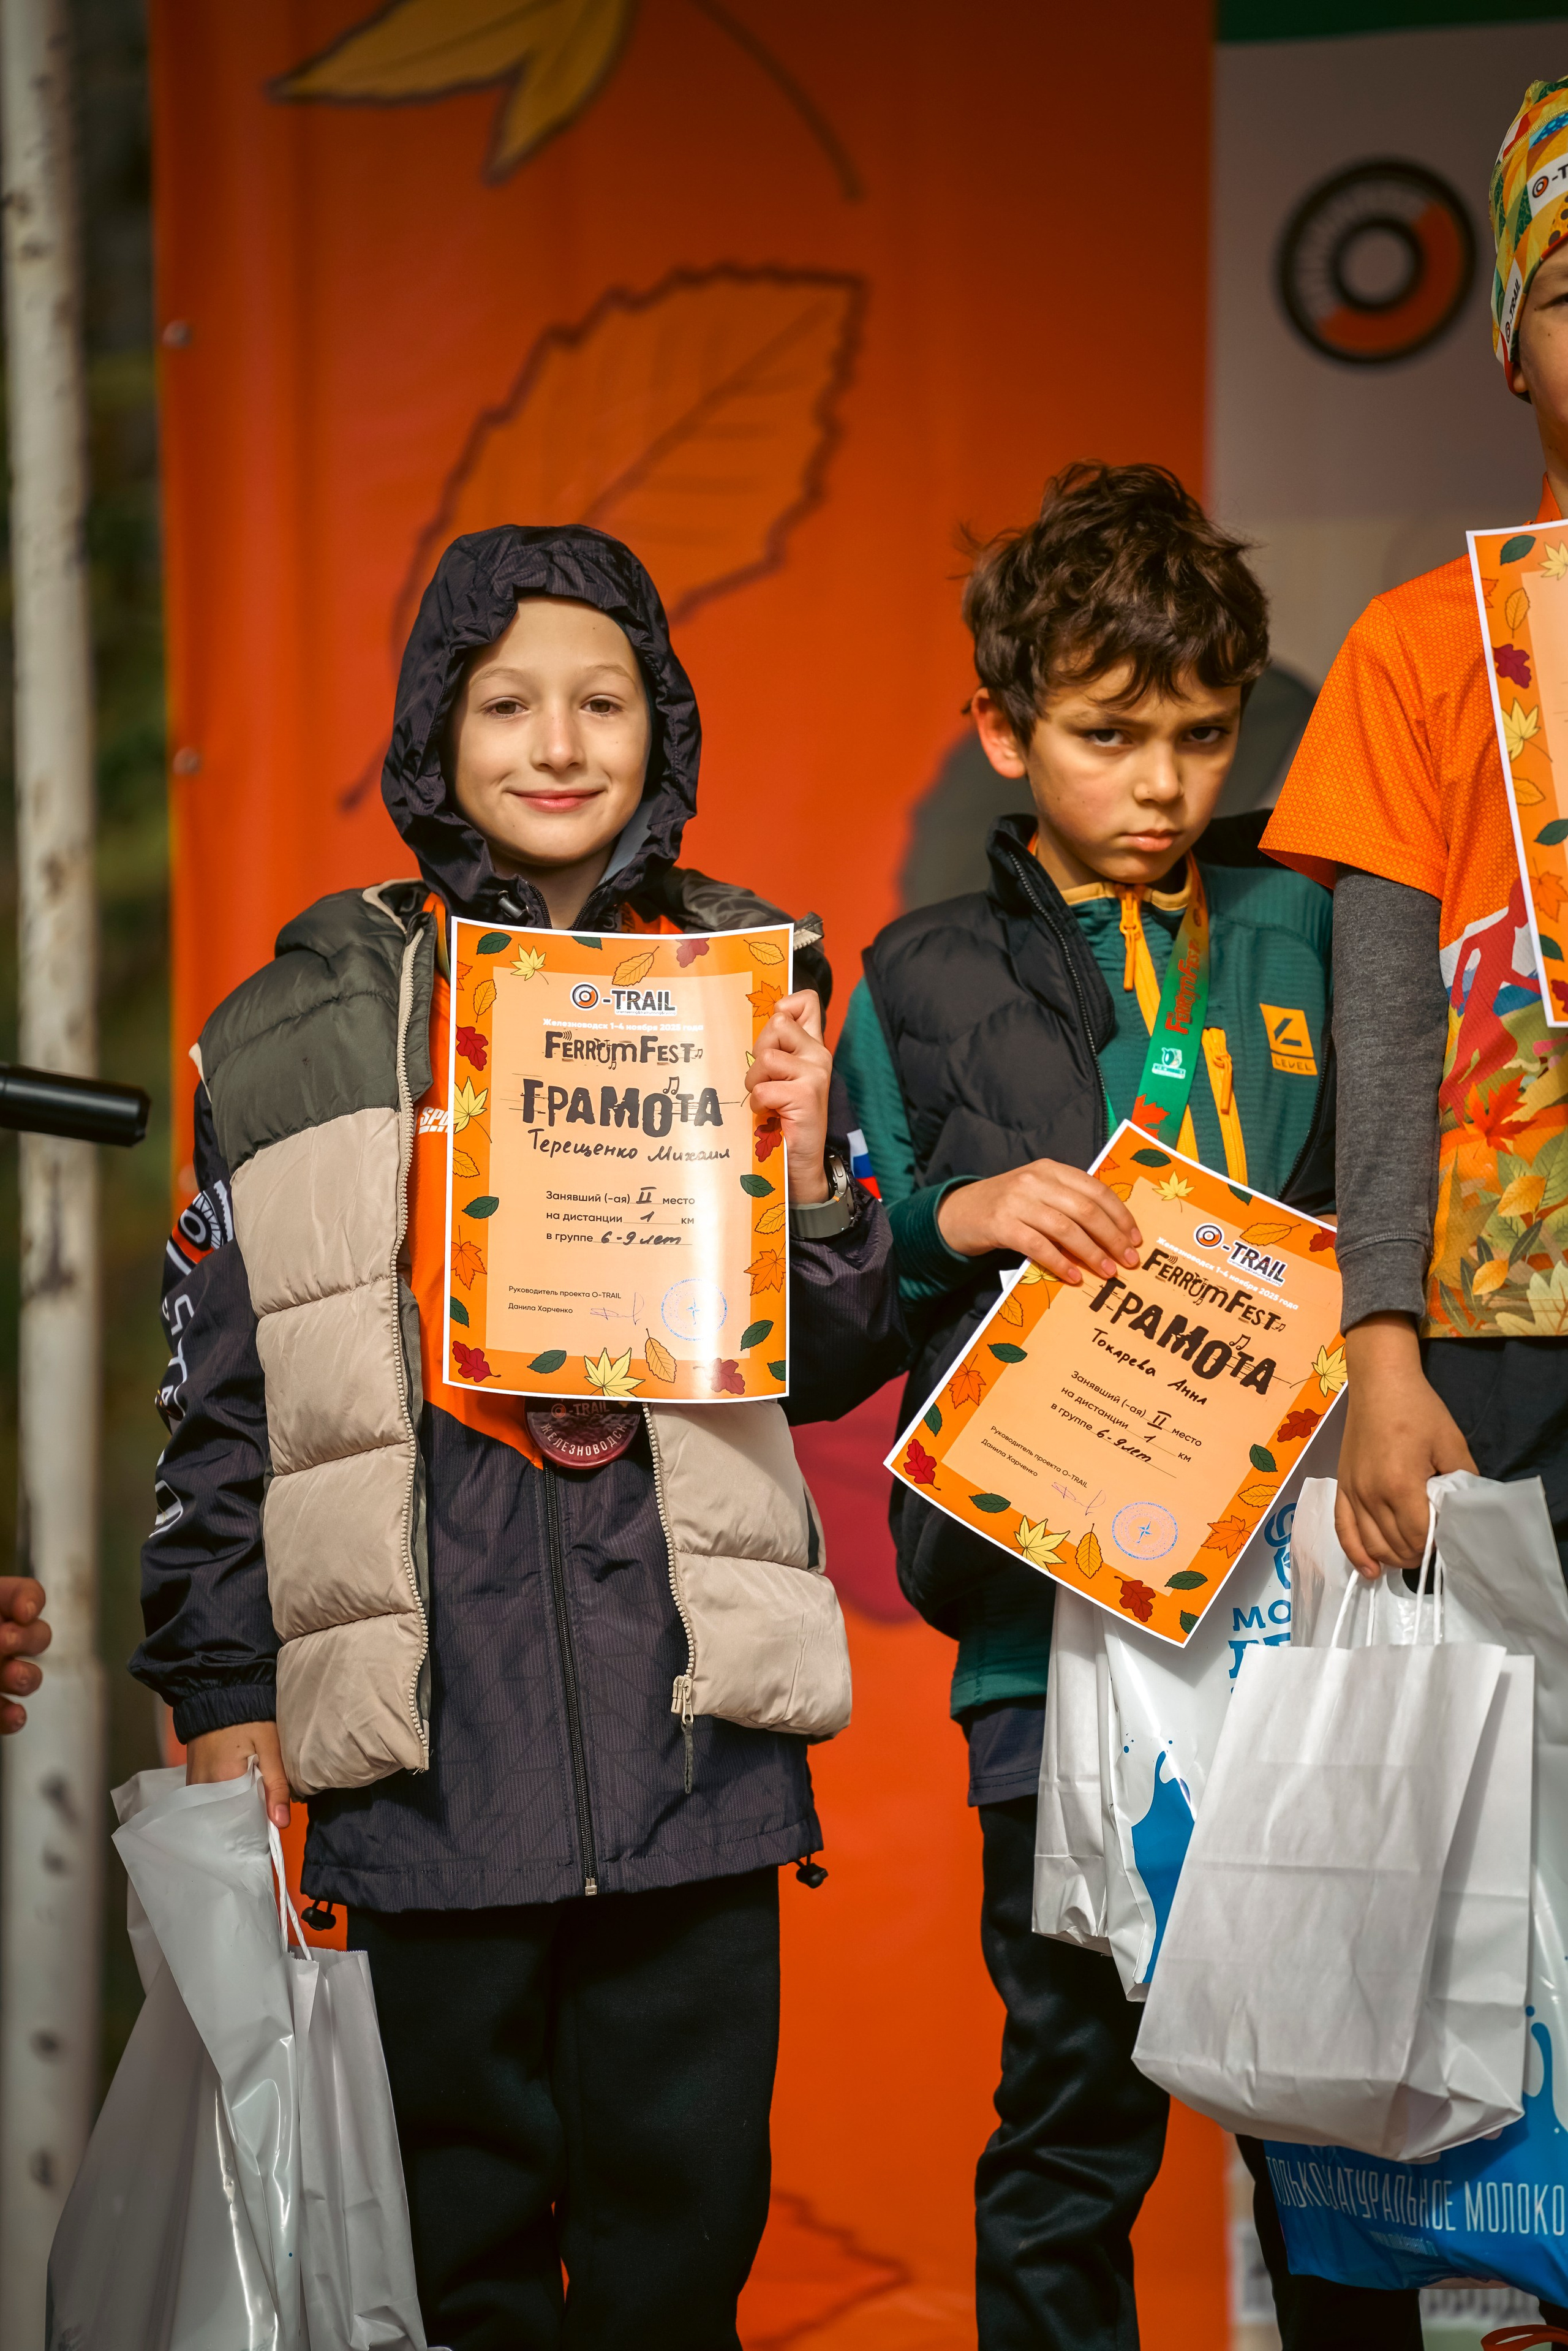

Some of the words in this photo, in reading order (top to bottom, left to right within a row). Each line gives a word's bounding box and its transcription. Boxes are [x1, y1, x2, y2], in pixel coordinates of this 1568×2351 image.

[543, 1018, 608, 1030] Железноводск
[626, 1023, 658, 1032] ноября
[1275, 1059, 1313, 1072] LEVEL
[522, 1078, 724, 1138] ГРАМОТА
[527, 1128, 639, 1158] Терещенко
[647, 1144, 731, 1163] Михаил
[546, 1191, 601, 1203] Занявший
[604, 1193, 631, 1204] (-ая)
[563, 1213, 623, 1224] дистанции
[640, 1210, 655, 1223] 1
[555, 1232, 594, 1243] группе
[639, 1234, 682, 1245] лет
[1156, 1236, 1215, 1271] Железноводск
[1229, 1274, 1259, 1292] ноября
[1257, 1287, 1280, 1302] 2025
[1278, 1298, 1299, 1310] года
[508, 1285, 559, 1296] Руководитель
[560, 1290, 590, 1299] проекта
[508, 1302, 536, 1311] Данила
[537, 1304, 573, 1314] Харченко
[1088, 1276, 1277, 1395] ГРАМОТА
[1090, 1327, 1156, 1377] Токарева
[1166, 1379, 1208, 1405] Анна
[1058, 1405, 1093, 1431] группе
[1061, 1387, 1075, 1398] на
[1074, 1396, 1129, 1430] дистанции
[1177, 1452, 1192, 1463] км
[1071, 1370, 1121, 1404] Занявший
[1121, 1399, 1147, 1418] (-ая)
[1171, 1428, 1202, 1447] место
[540, 1422, 628, 1457] ЖЕЛЕЗНОВОДСК
[990, 1425, 1034, 1457] Руководитель
[1034, 1454, 1062, 1473] проекта
[1062, 1469, 1088, 1489] O-TRAIL
[981, 1438, 1006, 1457] Данила
[1006, 1454, 1038, 1477] Харченко
[1322, 2164, 1457, 2232] НАТУРАЛЬНОЕ
[1464, 2181, 1566, 2236] МОЛОКО
